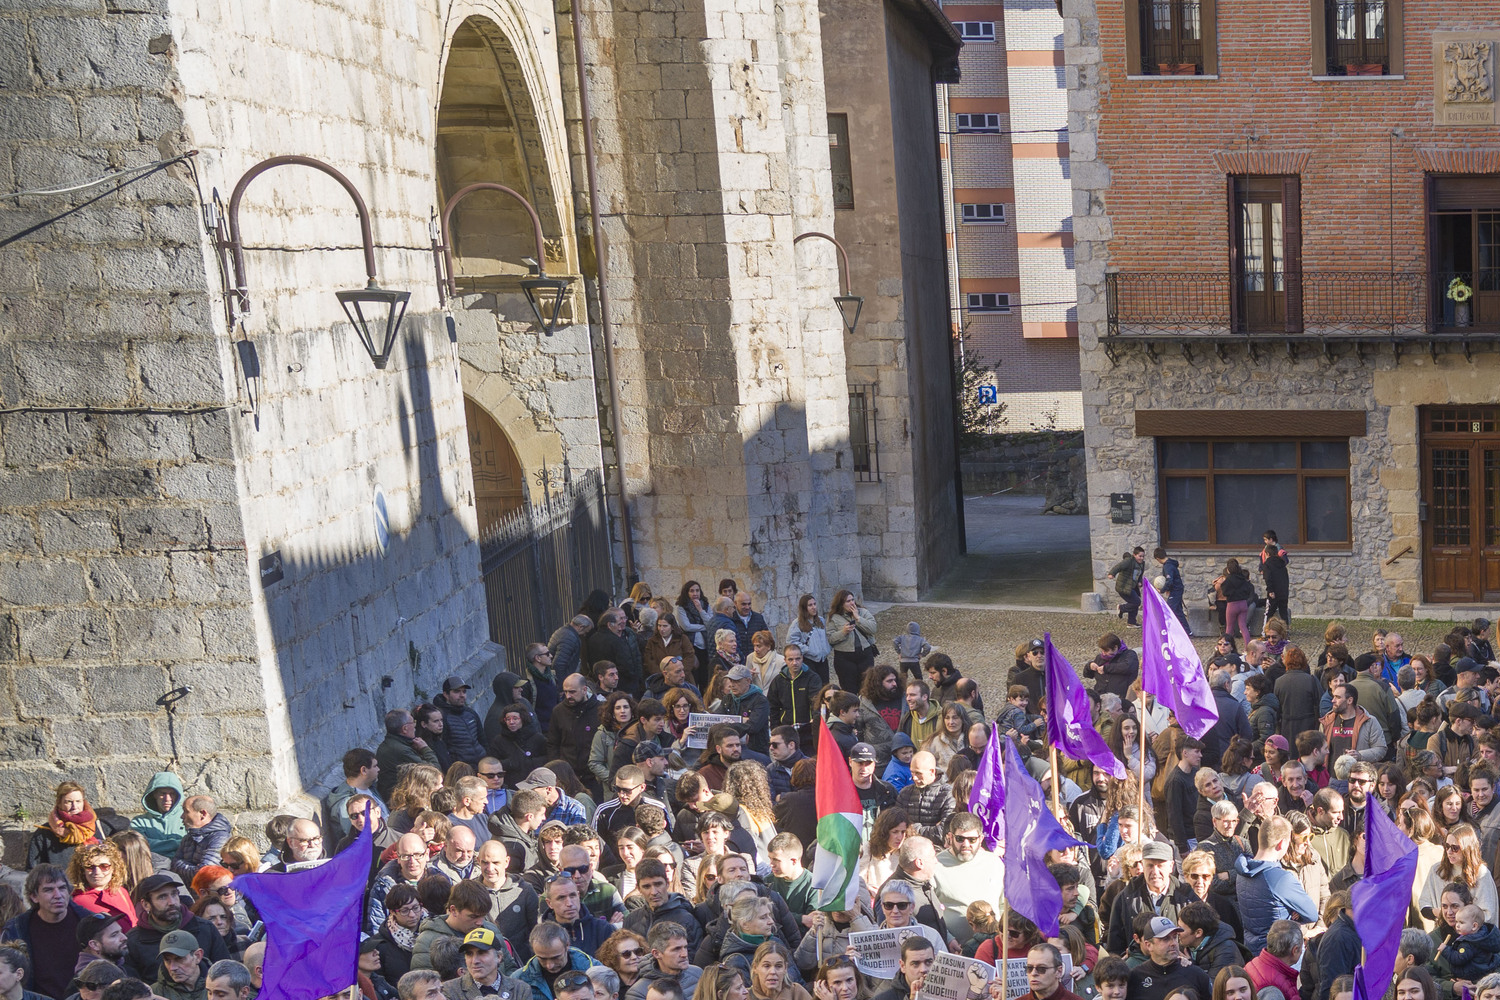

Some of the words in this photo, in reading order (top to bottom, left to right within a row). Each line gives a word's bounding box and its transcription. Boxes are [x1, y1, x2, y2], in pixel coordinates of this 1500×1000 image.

[854, 933, 896, 944] ELKARTASUNA
[873, 941, 897, 950] DELITUA
[940, 967, 964, 979] DELITUA
